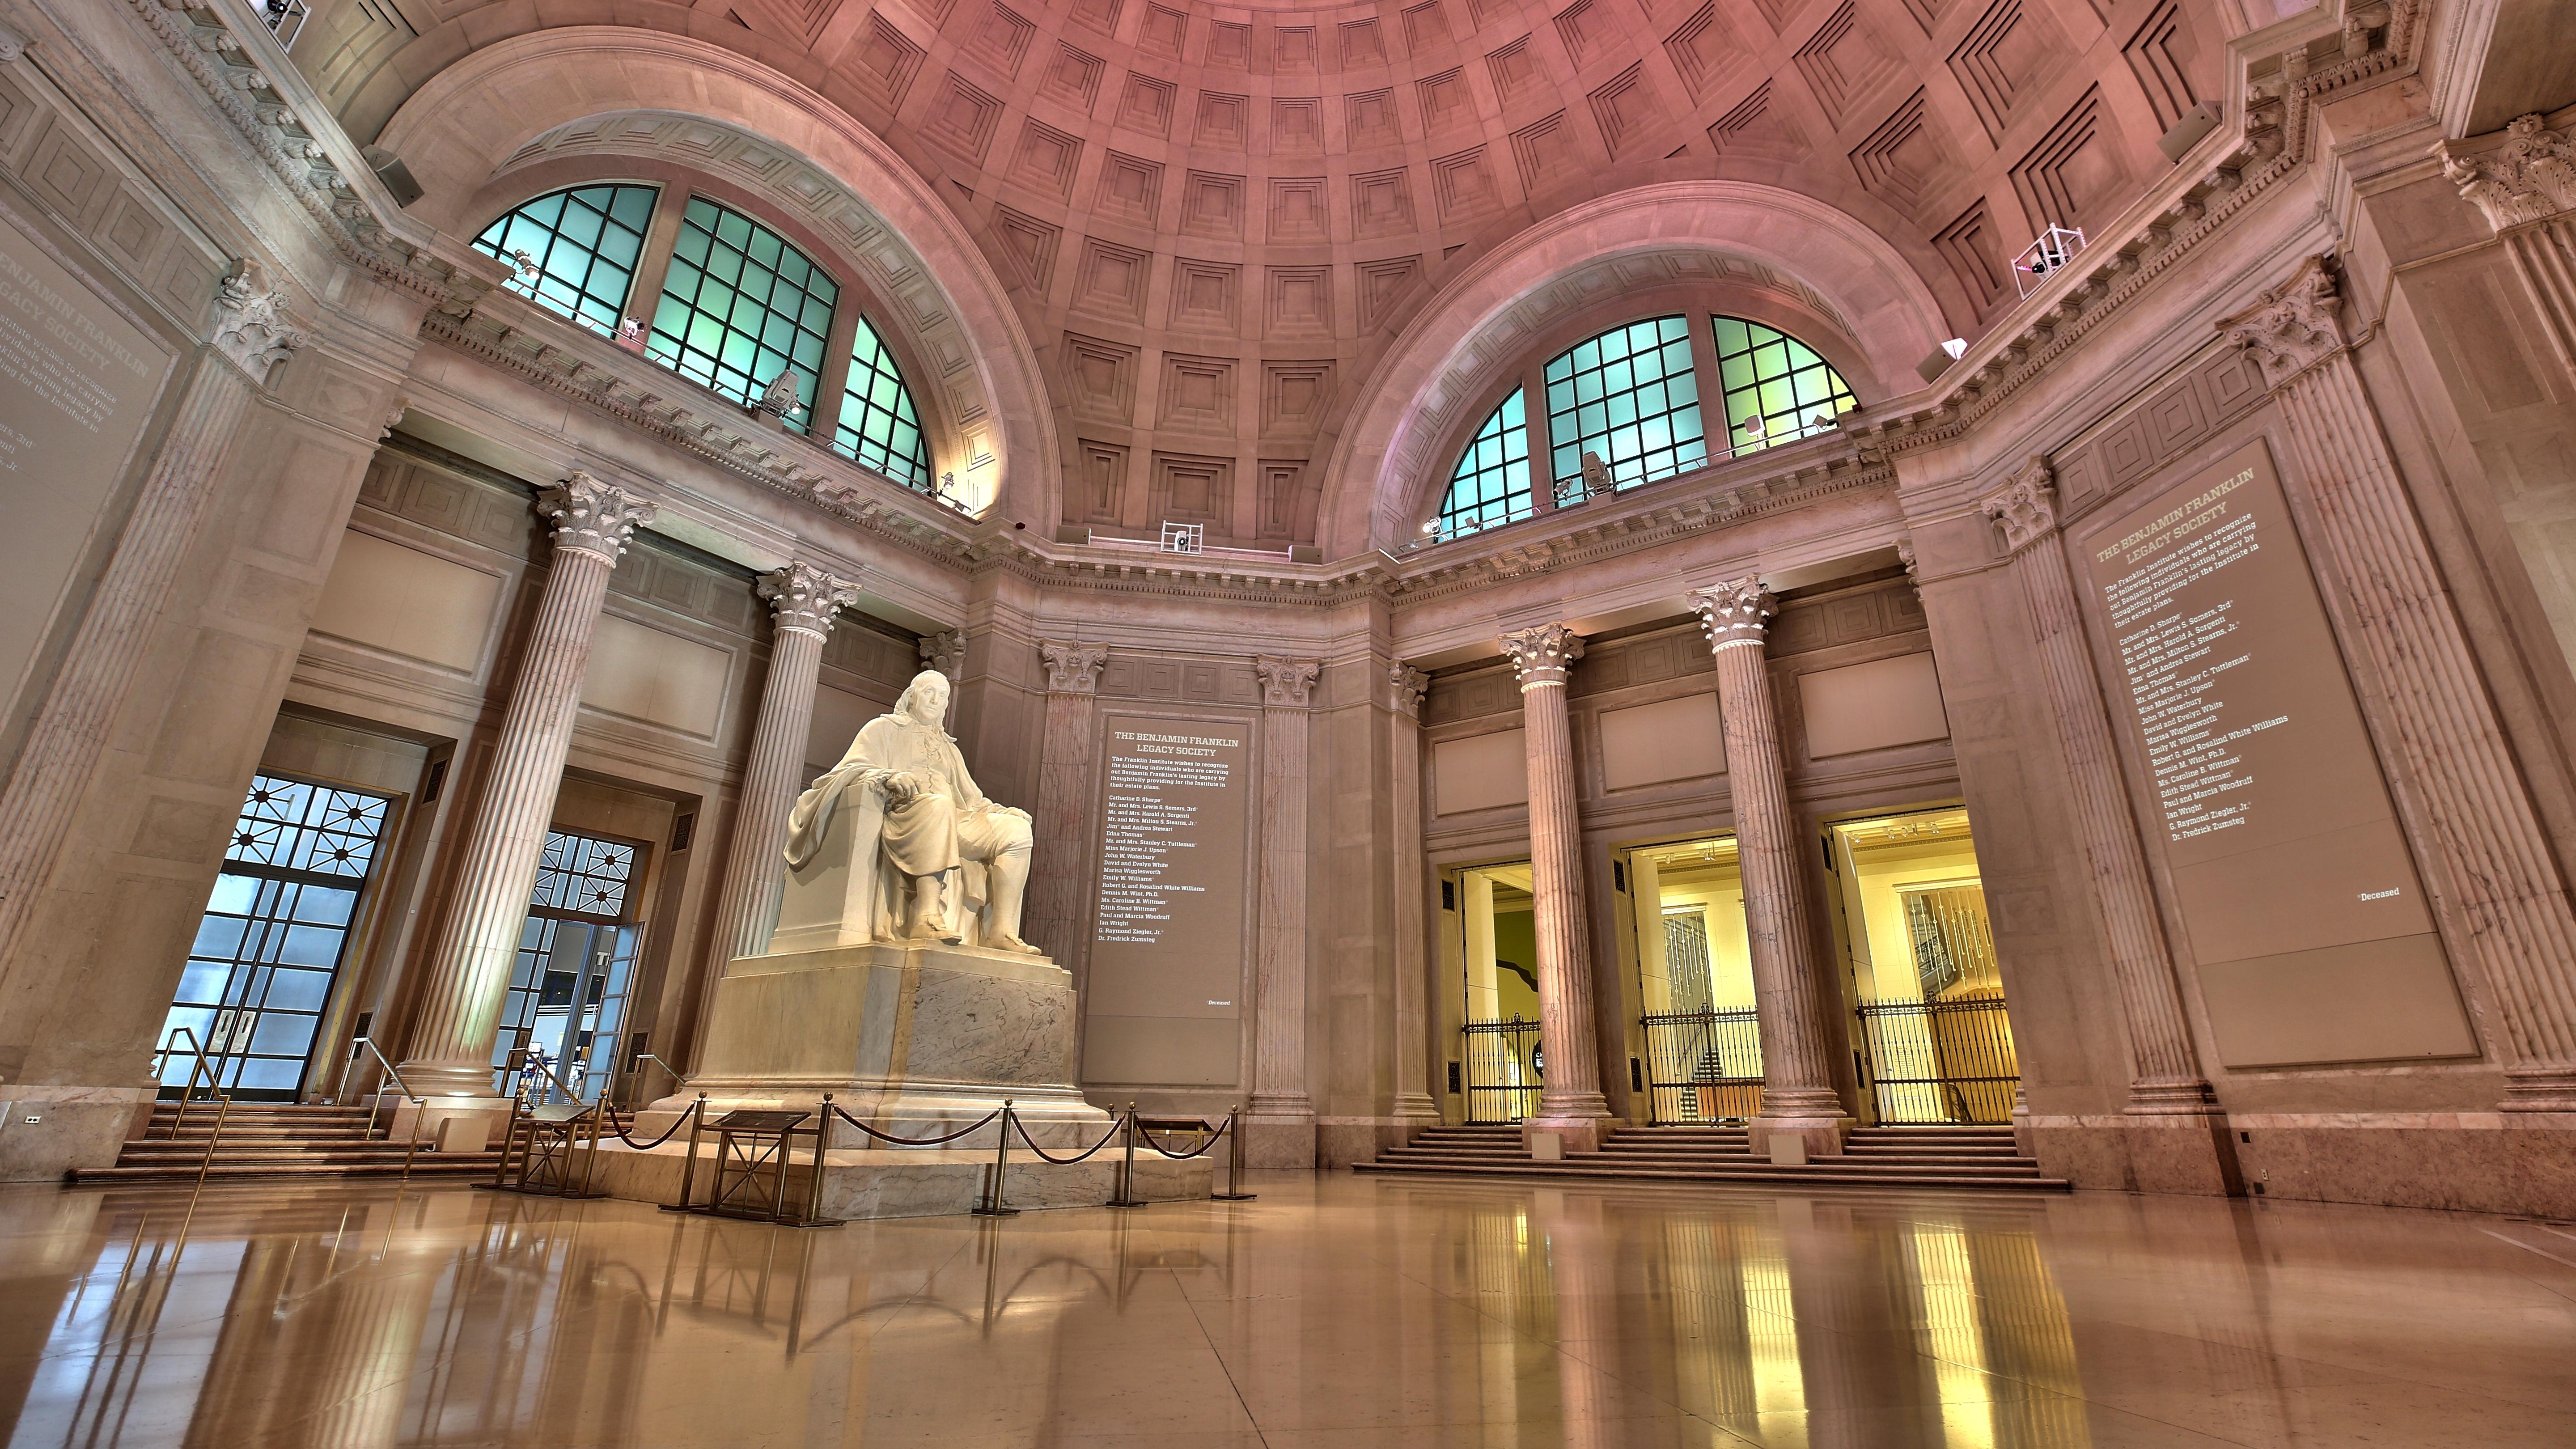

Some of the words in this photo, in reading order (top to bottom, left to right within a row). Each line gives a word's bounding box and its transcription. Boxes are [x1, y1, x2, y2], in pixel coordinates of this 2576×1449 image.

[0, 252, 76, 319] ENJAMIN
[74, 313, 149, 378] FRANKLIN
[0, 281, 46, 321] GACY
[44, 316, 110, 371] SOCIETY
[0, 314, 31, 340] stitute
[34, 338, 64, 365] wishes
[67, 363, 75, 373] to
[76, 371, 117, 403] recognize
[18, 373, 33, 387] for
[34, 384, 49, 398] the
[51, 396, 88, 426] Institute
[89, 424, 98, 433] in
[29, 365, 62, 393] lasting
[63, 389, 92, 414] legacy
[92, 410, 104, 422] by
[42, 360, 61, 377] who
[62, 377, 76, 389] are
[78, 386, 113, 415] carrying
[2096, 543, 2120, 563] THE
[2120, 507, 2183, 550] BENJAMIN
[2184, 467, 2254, 514] FRANKLIN
[2126, 532, 2171, 565] LEGACY
[2173, 501, 2227, 539] SOCIETY
[2105, 584, 2117, 593] The
[2118, 569, 2146, 587] Franklin
[2146, 553, 2176, 572] Institute
[2177, 538, 2203, 555] wishes
[2213, 513, 2252, 537] recognize
[2107, 593, 2118, 602] the
[2118, 576, 2150, 596] following
[2150, 556, 2190, 580] individuals
[2191, 547, 2207, 558] who
[2208, 540, 2221, 550] are
[2222, 521, 2256, 543] carrying
[2110, 602, 2121, 611] out
[2121, 586, 2153, 605] Benjamin
[2153, 568, 2189, 589] Franklin's
[2189, 553, 2216, 571] lasting
[2216, 540, 2242, 557] legacy
[2243, 534, 2254, 543] by
[2112, 596, 2152, 619] thoughtfully
[2153, 578, 2188, 600] providing
[2188, 572, 2199, 582] for
[2200, 566, 2213, 576] the
[2214, 549, 2248, 569] Institute
[2250, 543, 2259, 552] in
[2114, 617, 2130, 628] their
[2131, 607, 2152, 620] estate
[2152, 597, 2174, 611] plans.
[2124, 657, 2136, 665] Mr.
[2136, 650, 2148, 660] and
[2148, 645, 2164, 655] Mrs.
[2163, 632, 2187, 648] Harold
[2195, 615, 2226, 634] Sorgenti
[2141, 715, 2157, 725] John
[2157, 710, 2167, 718] W.
[2166, 697, 2202, 715] Waterbury
[2143, 722, 2163, 735] David
[2163, 717, 2177, 728] and
[2176, 710, 2201, 723] Evelyn
[2201, 701, 2224, 713] White
[2146, 733, 2170, 746] Marisa
[2169, 715, 2218, 737] Wigglesworth
[1114, 731, 1135, 740] THE
[1136, 733, 1188, 744] BENJAMIN
[1189, 737, 1239, 747] FRANKLIN
[1136, 744, 1175, 754] LEGACY
[1176, 747, 1216, 757] SOCIETY
[2152, 754, 2174, 767] Robert
[2182, 746, 2196, 756] and
[2196, 734, 2229, 751] Rosalind
[2228, 728, 2252, 740] White
[2251, 715, 2288, 732] Williams
[2155, 764, 2178, 777] Dennis
[2178, 760, 2188, 769] M.
[2188, 754, 2208, 765] Wint,
[2207, 748, 2227, 759] Ph.D.
[2163, 798, 2179, 809] Paul
[2179, 794, 2193, 804] and
[2193, 788, 2219, 800] Marcia
[2218, 775, 2253, 792] Woodruff
[2165, 811, 2178, 819] Ian
[2178, 804, 2203, 815] Wright
[2182, 825, 2212, 839] Fredrick
[2212, 817, 2245, 830] Zumsteg
